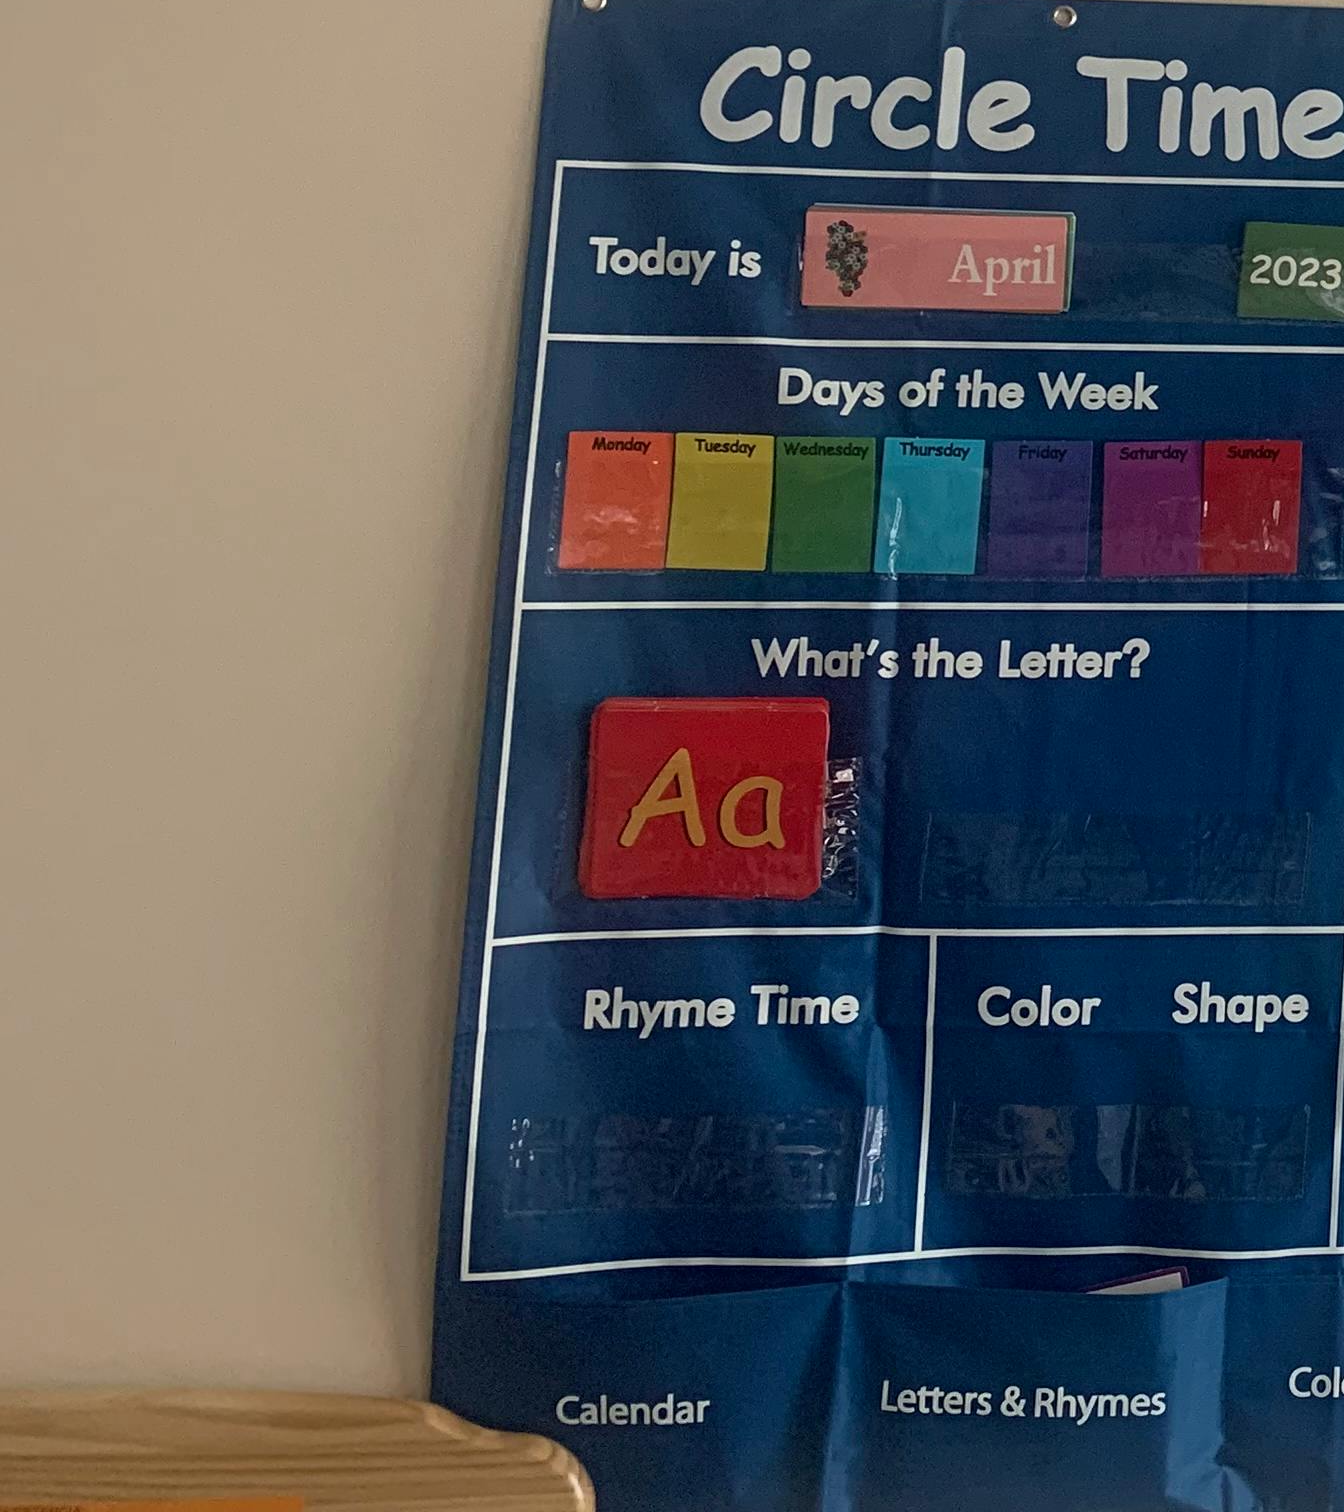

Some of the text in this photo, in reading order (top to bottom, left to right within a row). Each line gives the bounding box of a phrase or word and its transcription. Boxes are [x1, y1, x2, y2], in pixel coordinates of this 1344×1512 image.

[700, 45, 1035, 152] Circle
[589, 236, 762, 286] Today is
[947, 243, 1058, 298] April
[1250, 254, 1342, 291] 2023
[778, 367, 1159, 416] Days of the Week
[592, 437, 651, 454] Monday
[695, 438, 756, 458] Tuesday
[783, 442, 869, 460] Wednesday
[900, 442, 970, 461] Thursday
[1018, 445, 1067, 462] Friday
[1119, 446, 1189, 462] Saturday
[1226, 445, 1280, 462] Sunday
[751, 636, 1150, 679] What's the Letter?
[619, 747, 786, 851] Aa
[584, 984, 860, 1029] Rhyme Time
[978, 984, 1102, 1027] Color
[1172, 981, 1309, 1033] Shape
[556, 1393, 710, 1425] Calendar
[881, 1380, 1166, 1426] Letters & Rhymes
